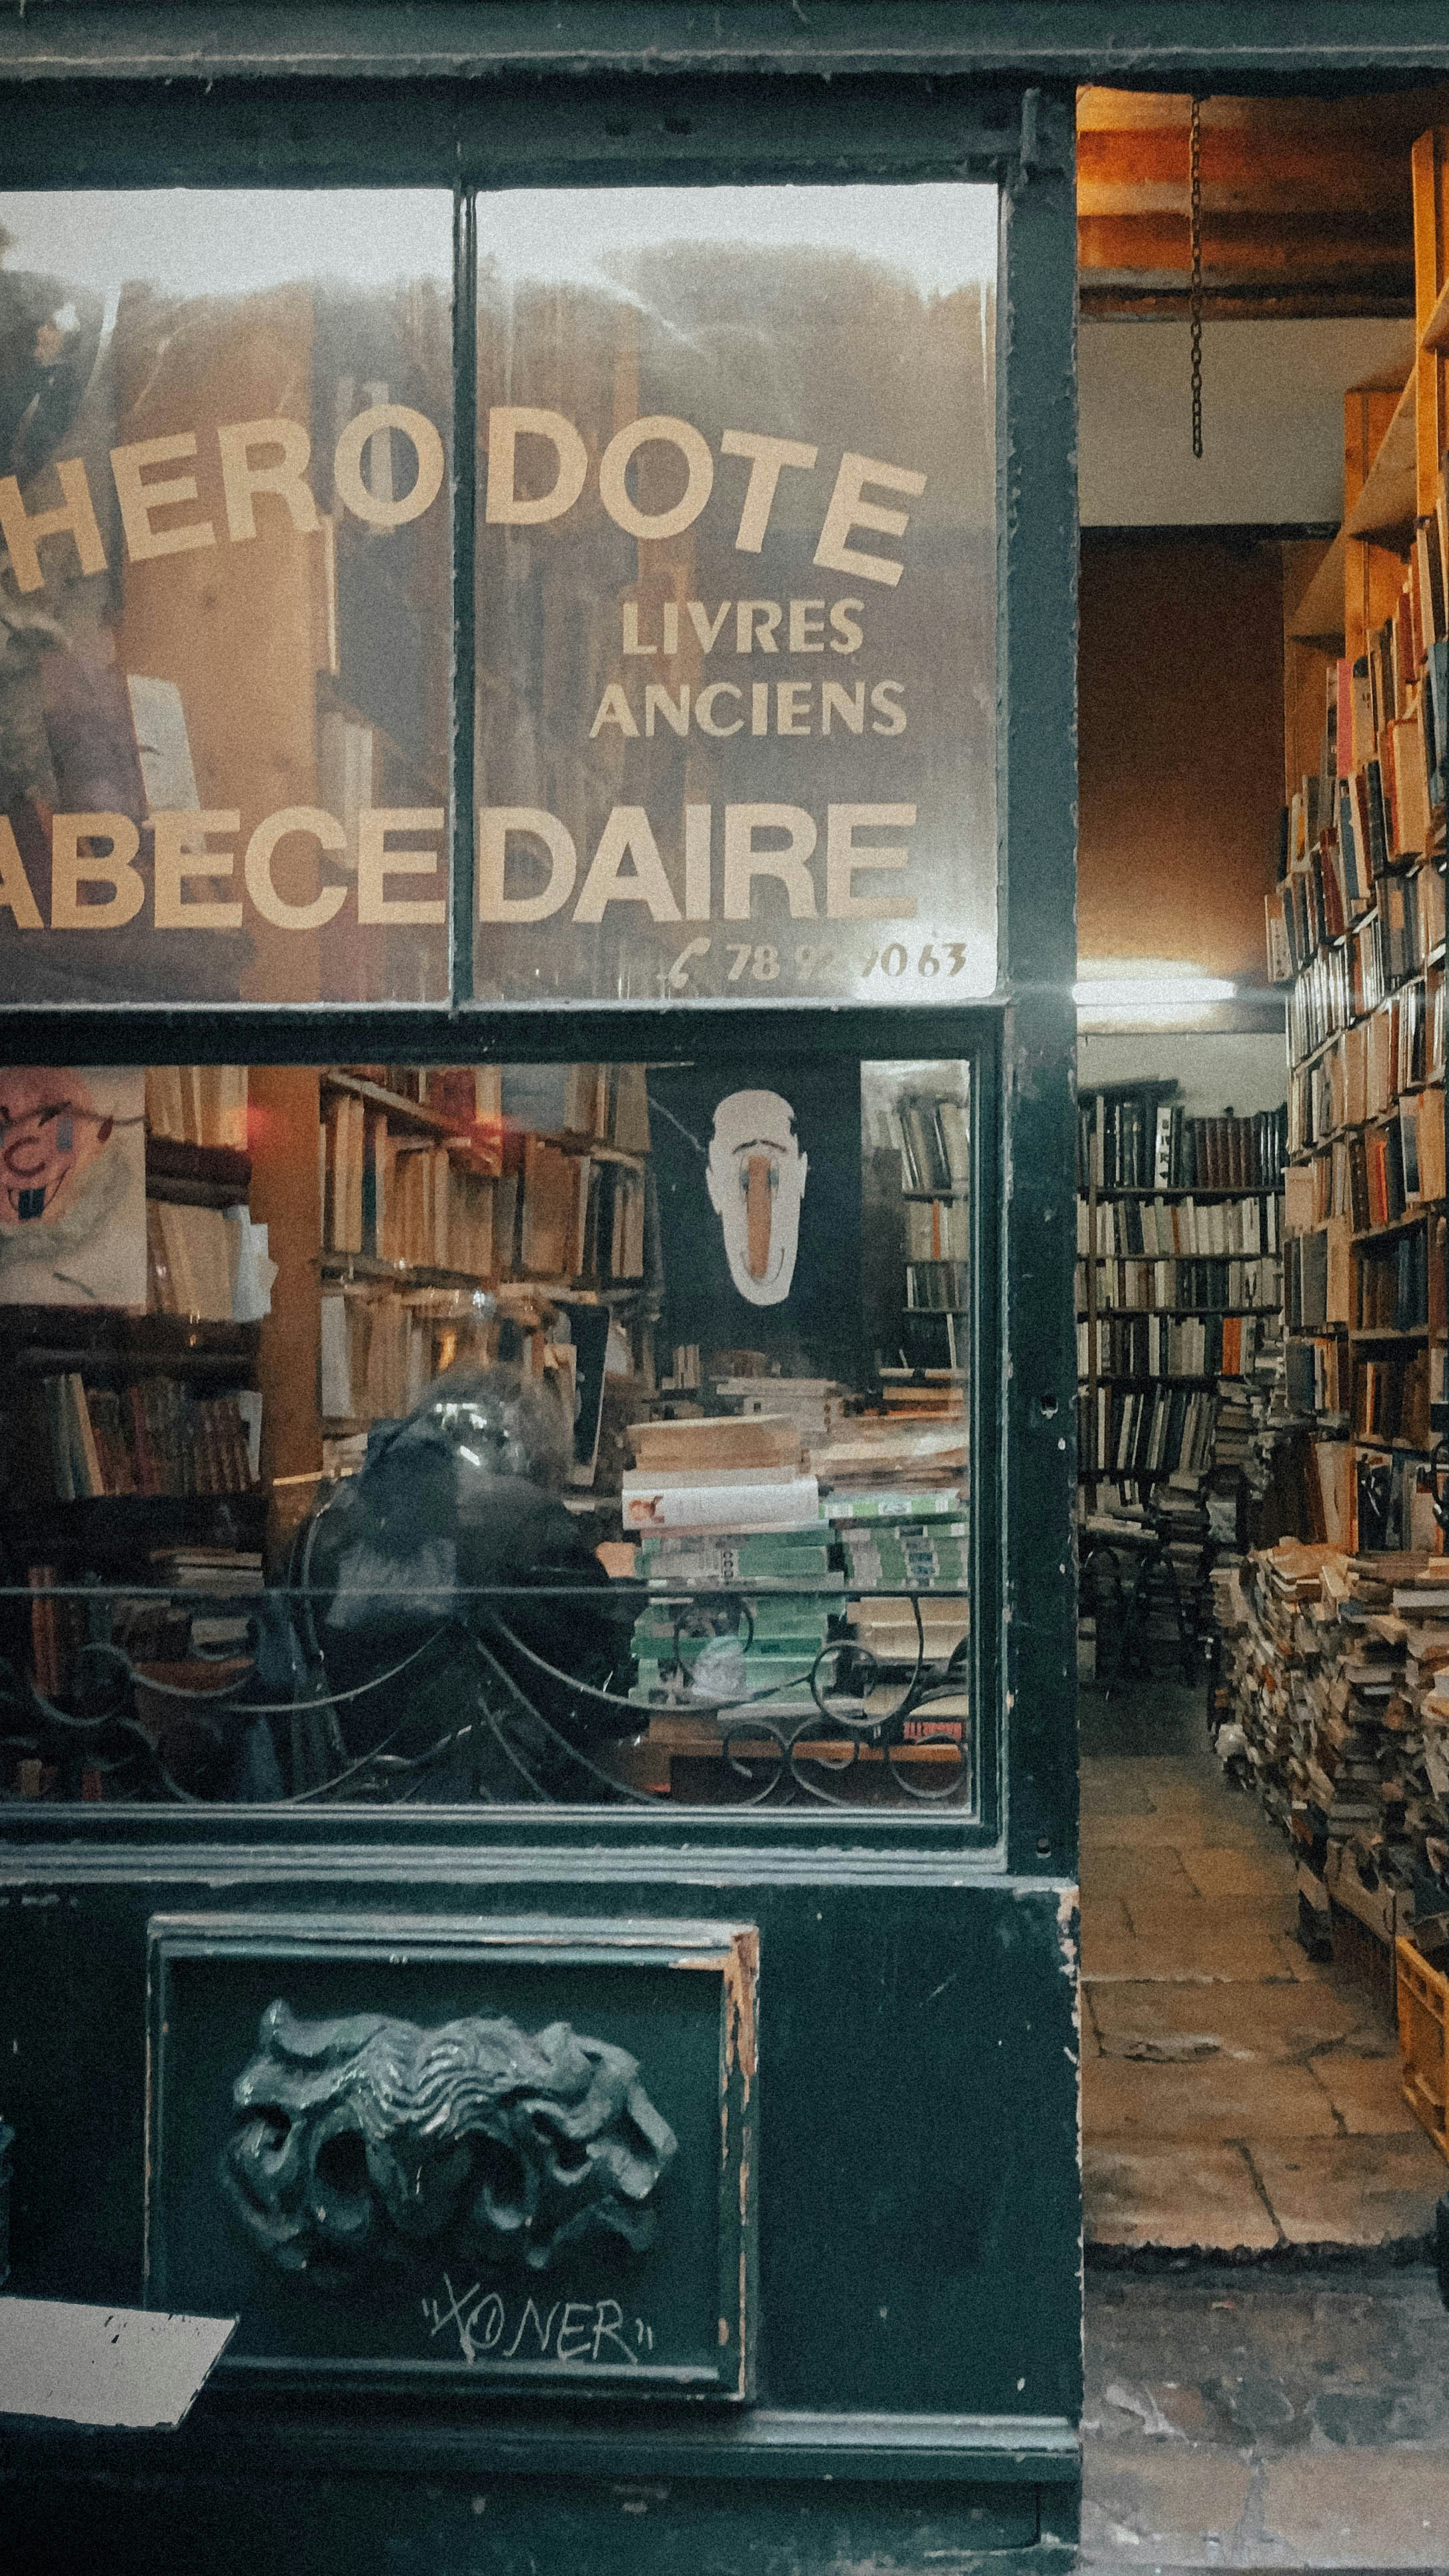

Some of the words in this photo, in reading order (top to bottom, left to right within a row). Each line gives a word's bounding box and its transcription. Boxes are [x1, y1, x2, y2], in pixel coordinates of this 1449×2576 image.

[0, 404, 928, 593] HERODOTE
[622, 598, 865, 655] LIVRES
[589, 680, 908, 738] ANCIENS
[726, 944, 781, 982] 78
[917, 942, 968, 978] 63
